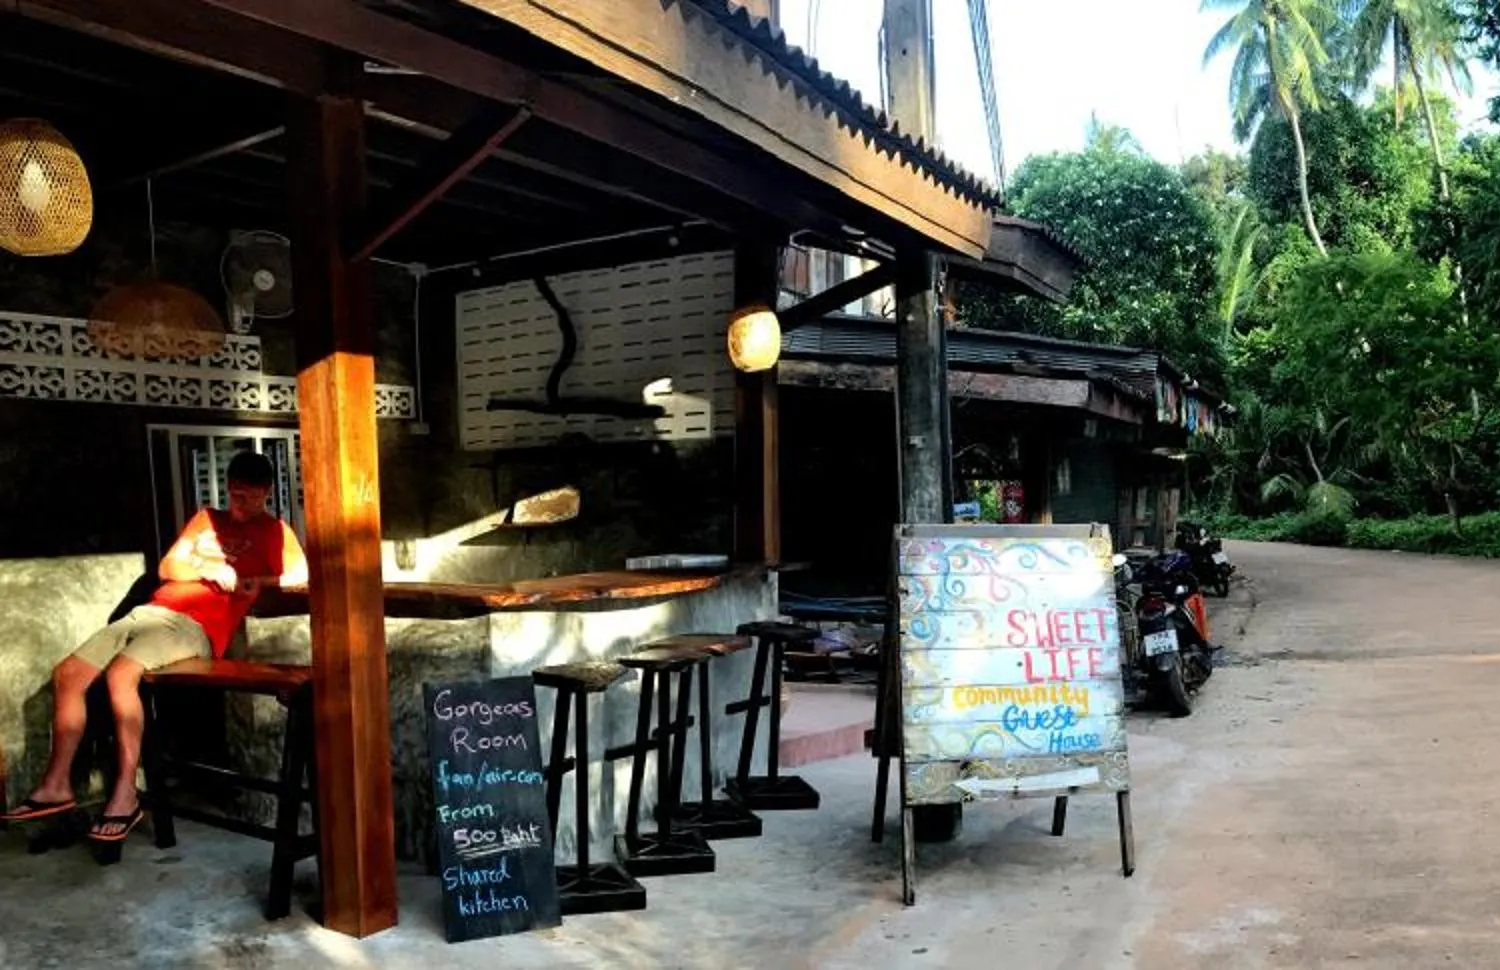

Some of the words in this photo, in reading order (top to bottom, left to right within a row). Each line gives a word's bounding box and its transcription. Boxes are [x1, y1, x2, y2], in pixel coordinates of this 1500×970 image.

[1007, 607, 1114, 649] SWEET
[1022, 647, 1106, 684] LIFE
[1049, 730, 1101, 753] House
[436, 803, 495, 824] From
[453, 826, 497, 849] 500
[443, 855, 512, 891] Shared
[458, 889, 529, 917] kitchen
